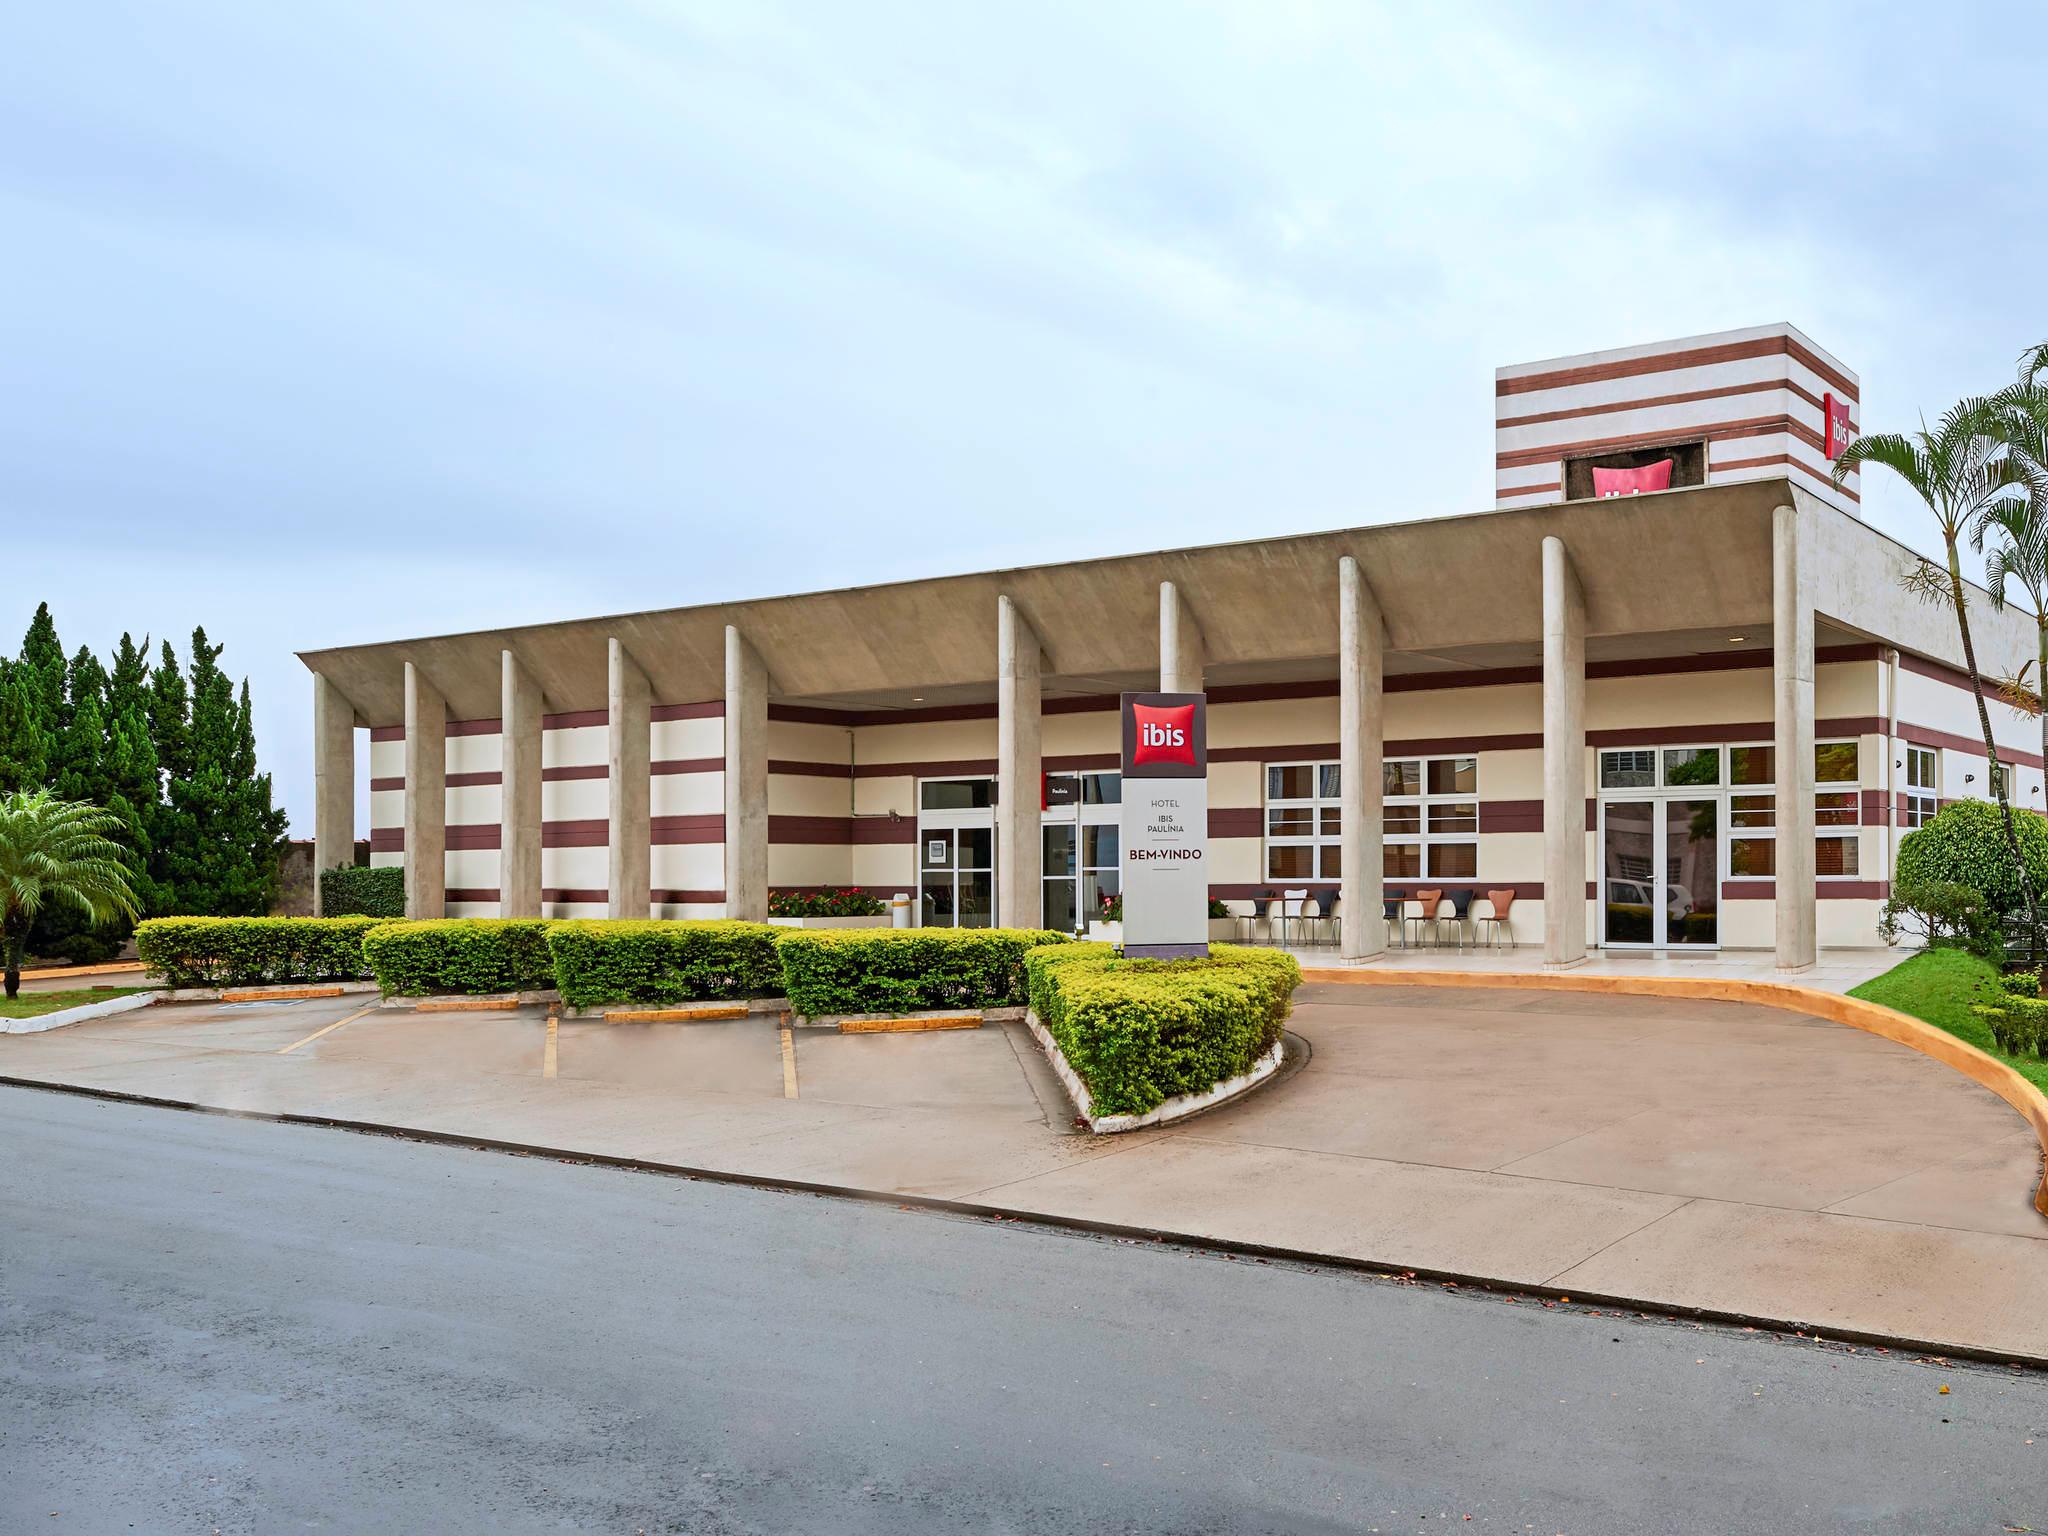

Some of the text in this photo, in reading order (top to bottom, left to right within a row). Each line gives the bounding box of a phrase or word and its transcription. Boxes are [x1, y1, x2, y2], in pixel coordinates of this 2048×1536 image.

[1833, 415, 1847, 445] ibis
[1144, 724, 1184, 747] ibis
[1151, 799, 1180, 808] HOTEL
[1158, 815, 1173, 823] IBIS
[1147, 824, 1184, 833] PAULÍNIA
[1130, 849, 1202, 860] BEM-VINDO
